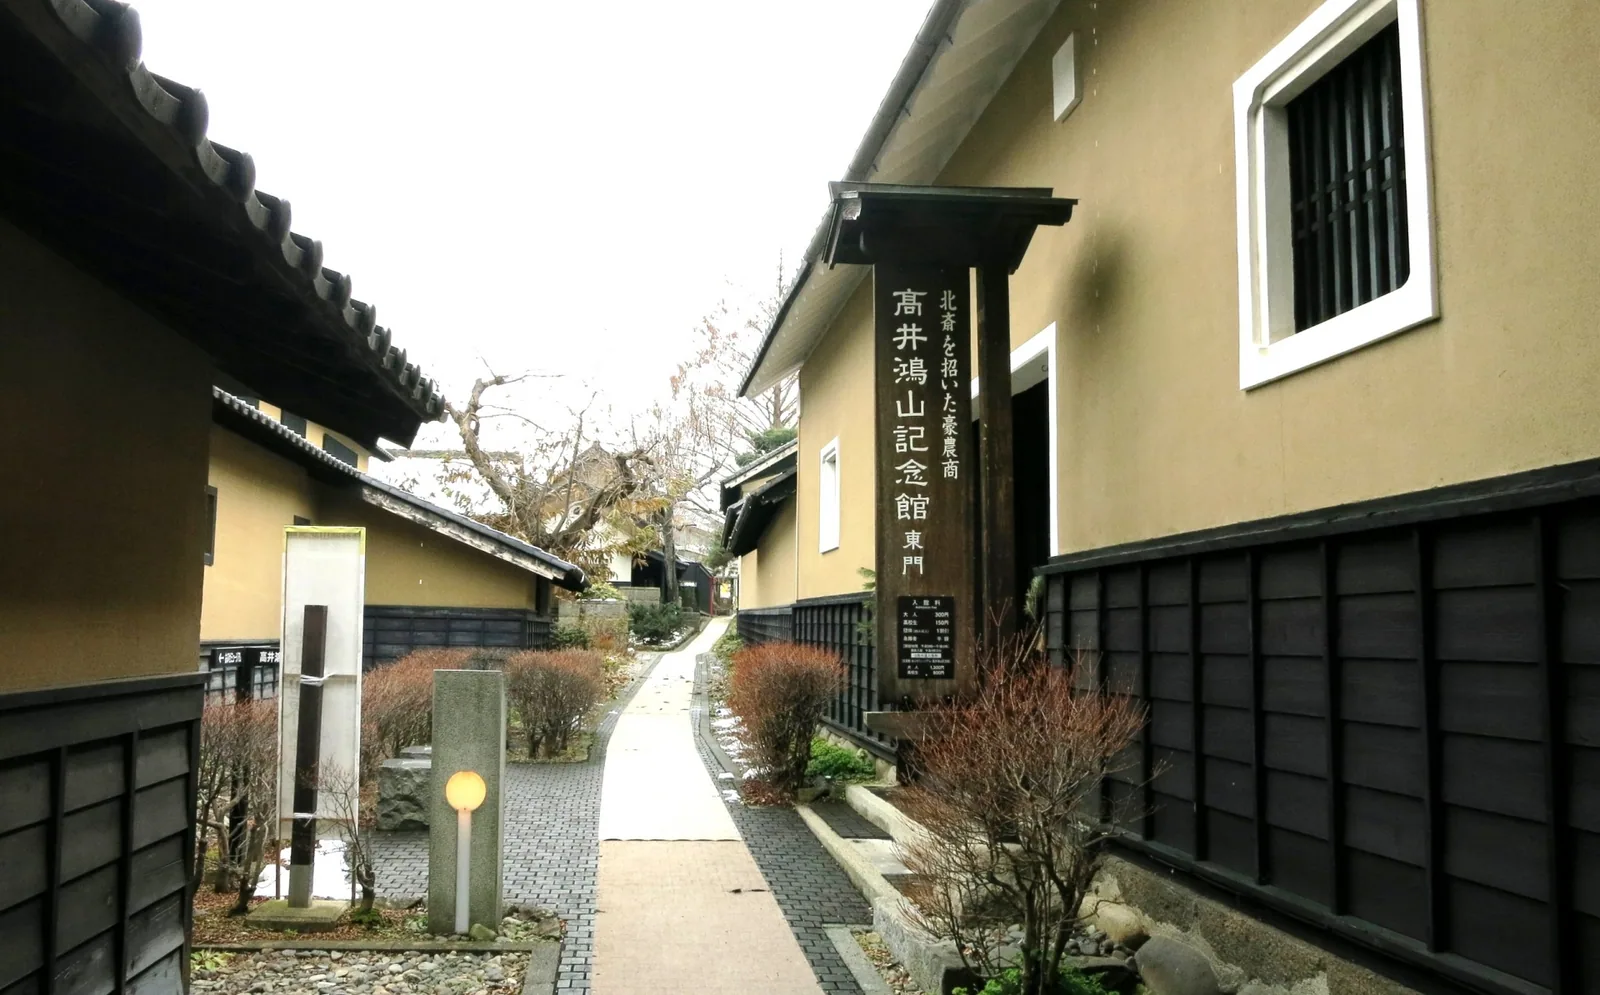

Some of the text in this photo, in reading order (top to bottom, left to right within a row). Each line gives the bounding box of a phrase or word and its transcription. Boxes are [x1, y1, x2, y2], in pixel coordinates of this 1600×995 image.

[939, 290, 960, 480] 北斎を招いた豪農商
